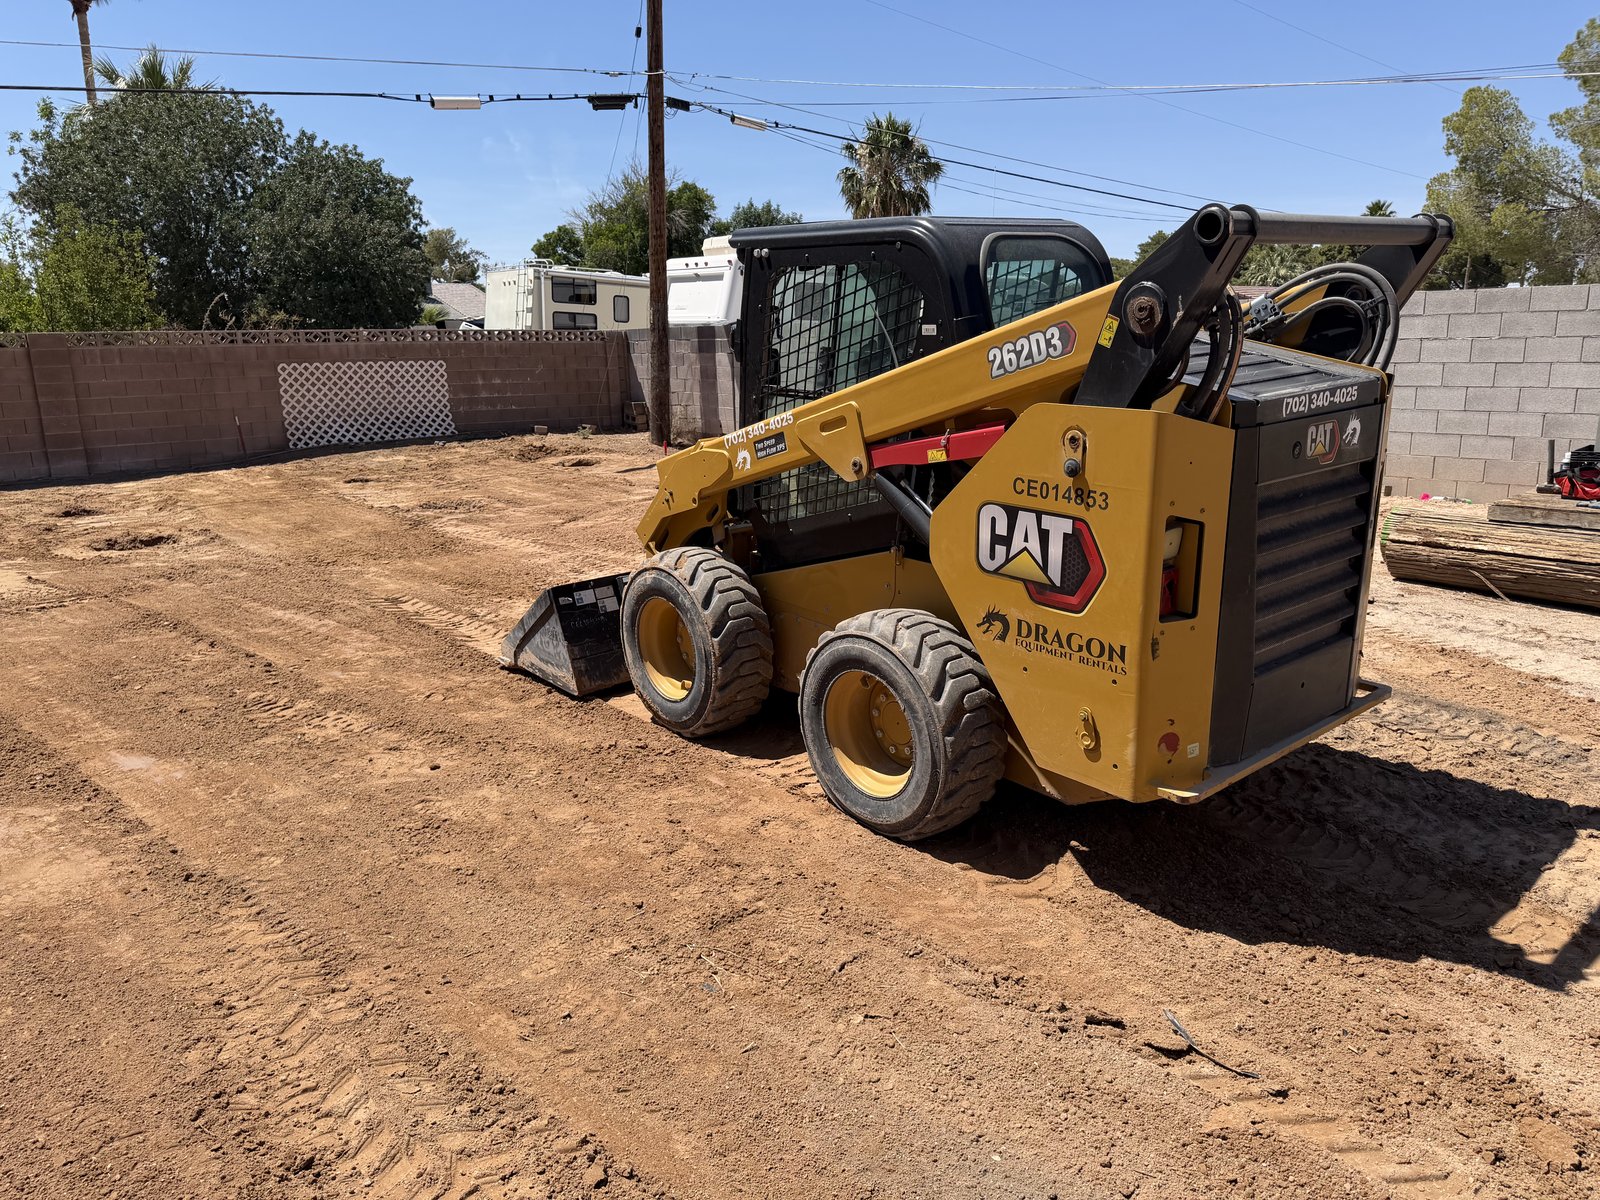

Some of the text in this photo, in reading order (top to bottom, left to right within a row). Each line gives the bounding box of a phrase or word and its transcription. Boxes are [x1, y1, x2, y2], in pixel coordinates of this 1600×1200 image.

[988, 325, 1063, 378] 262D3
[1282, 386, 1358, 417] (702) 340-4025
[723, 412, 794, 449] (702) 340-4025
[1306, 422, 1333, 457] CAT
[1012, 477, 1109, 511] CE014853
[978, 504, 1073, 588] CAT
[1015, 638, 1128, 676] EQUIPMENT RENTALS
[1016, 618, 1127, 665] DRAGON
